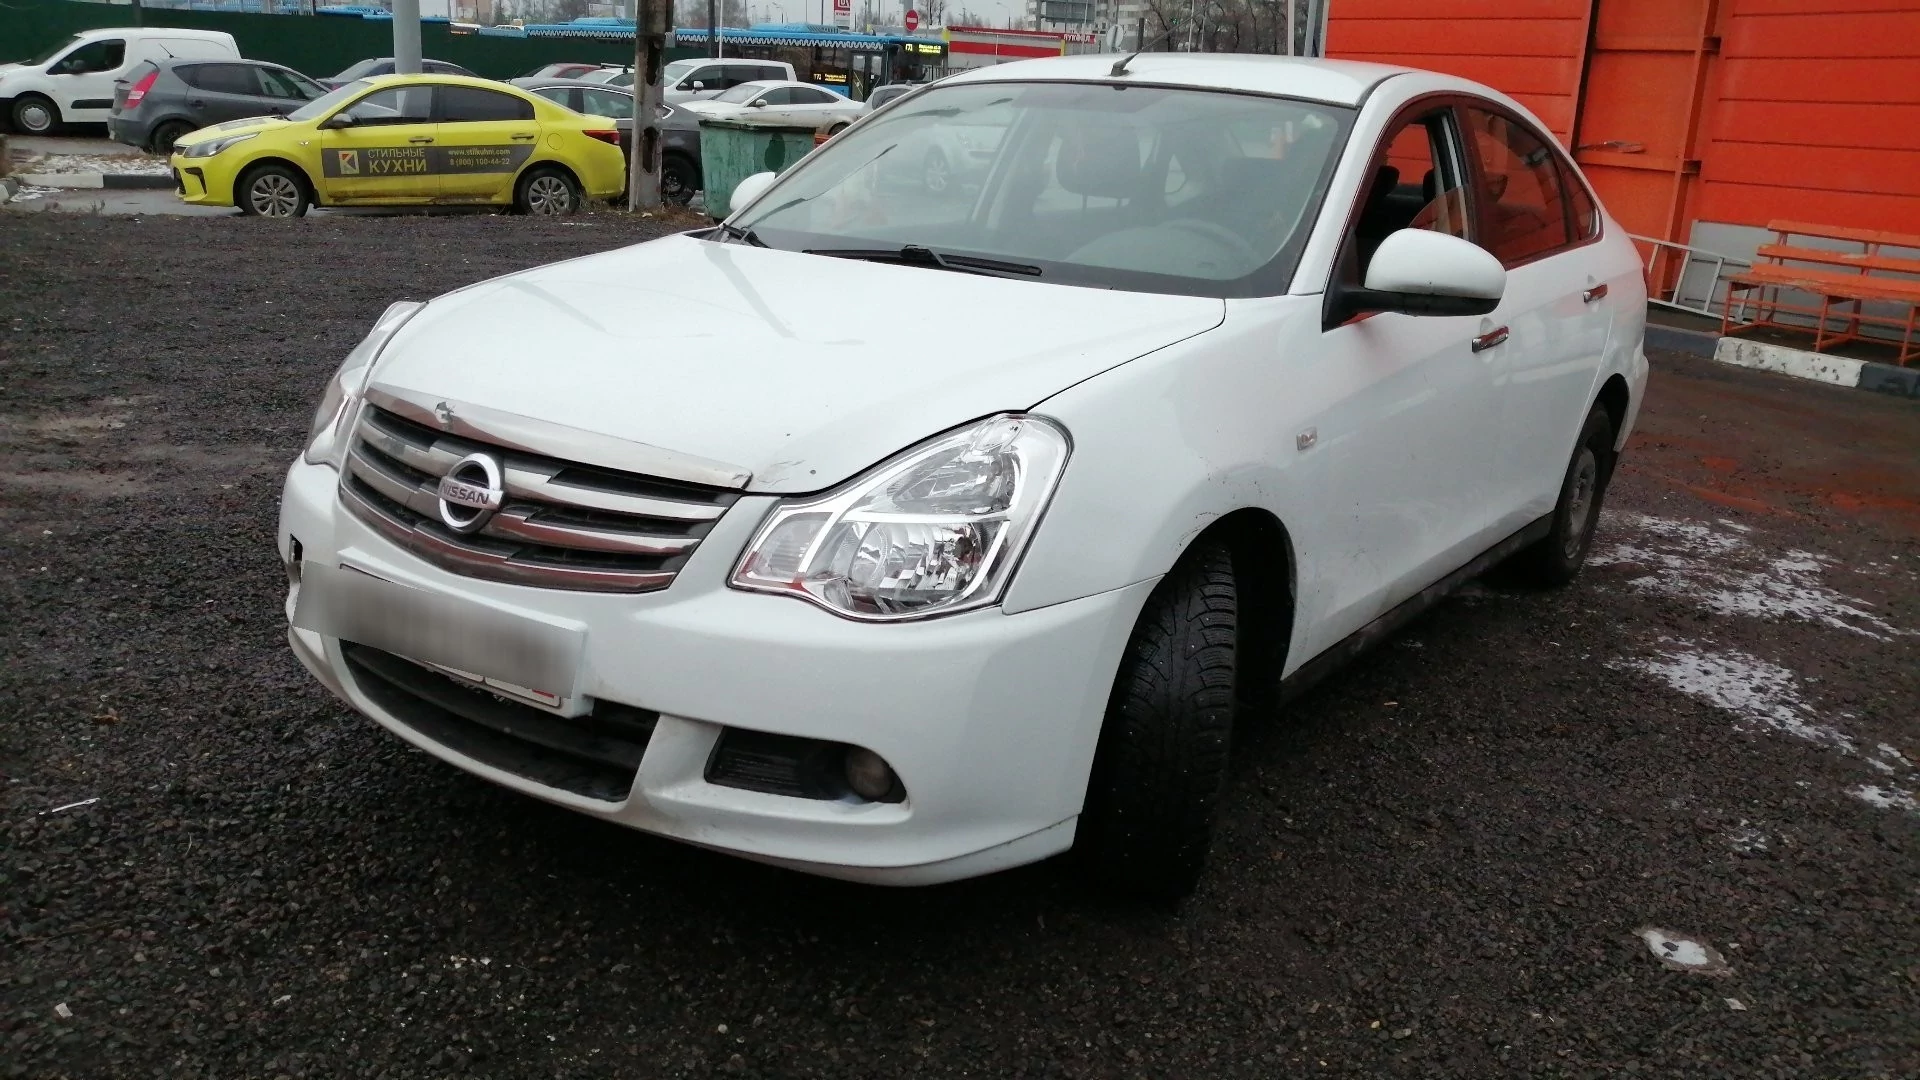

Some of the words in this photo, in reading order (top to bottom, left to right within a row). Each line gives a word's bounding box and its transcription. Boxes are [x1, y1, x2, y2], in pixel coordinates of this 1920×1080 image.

[367, 148, 426, 159] СТИЛЬНЫЕ
[369, 158, 427, 174] КУХНИ
[440, 483, 490, 505] NISSAN
